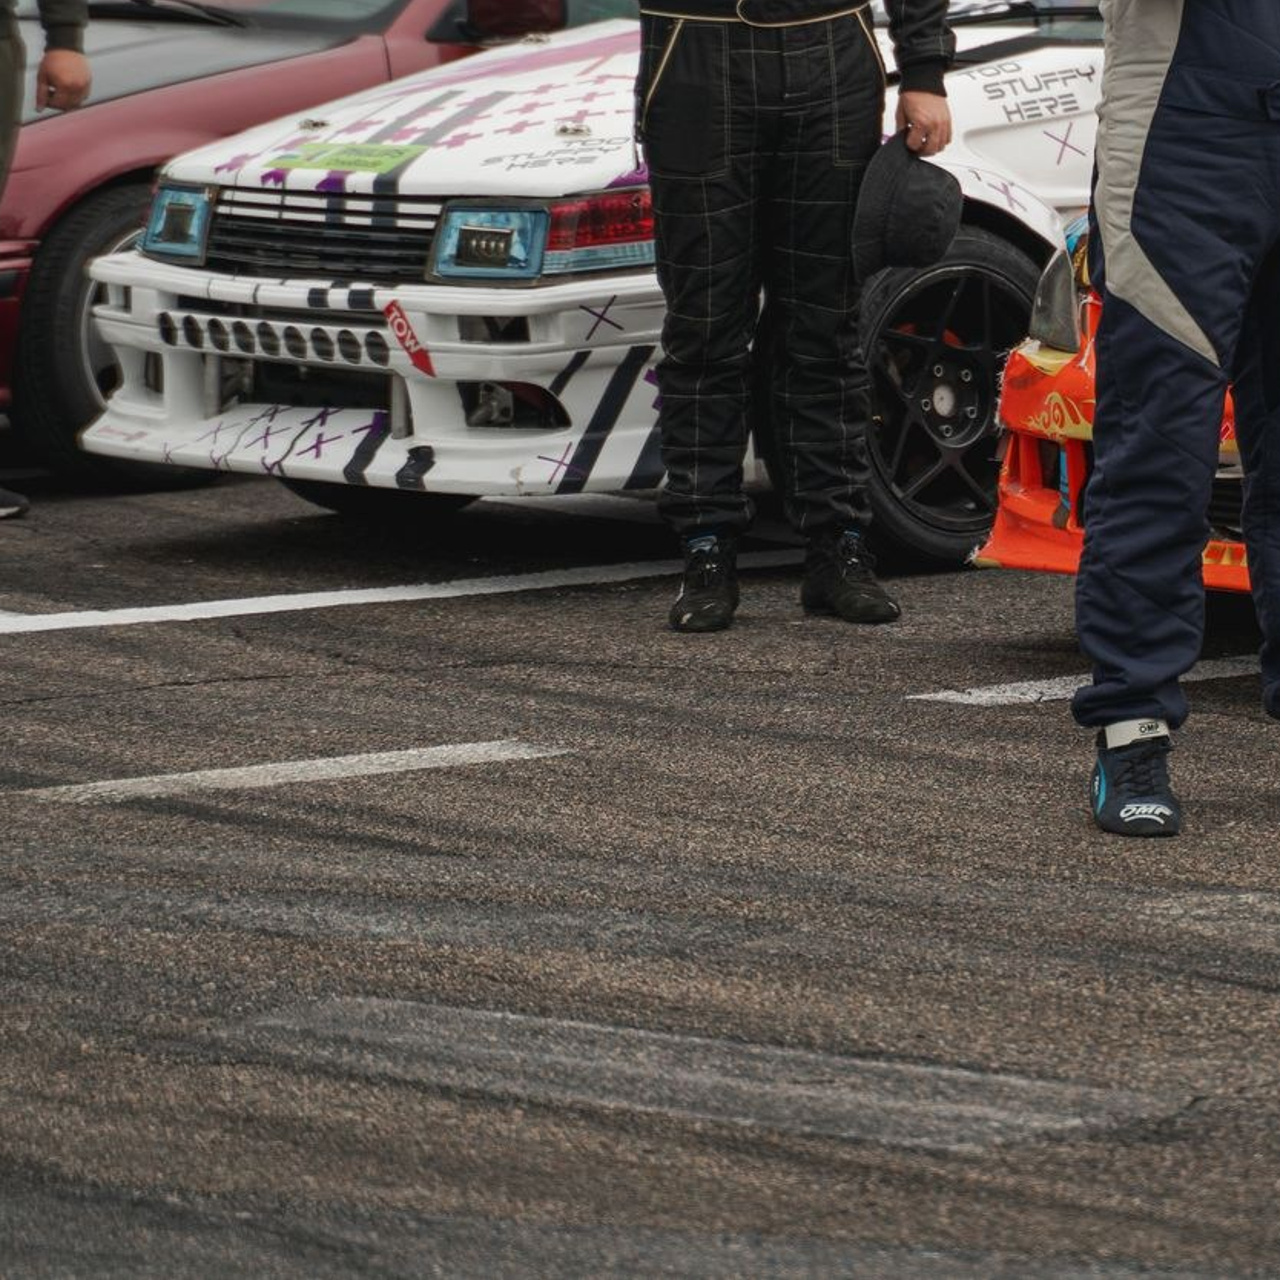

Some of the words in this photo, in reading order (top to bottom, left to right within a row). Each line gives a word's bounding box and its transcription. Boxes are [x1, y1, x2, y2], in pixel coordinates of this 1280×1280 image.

[957, 62, 1022, 80] TOO
[983, 65, 1096, 100] STUFFY
[1002, 93, 1080, 122] HERE
[388, 306, 420, 353] TOW
